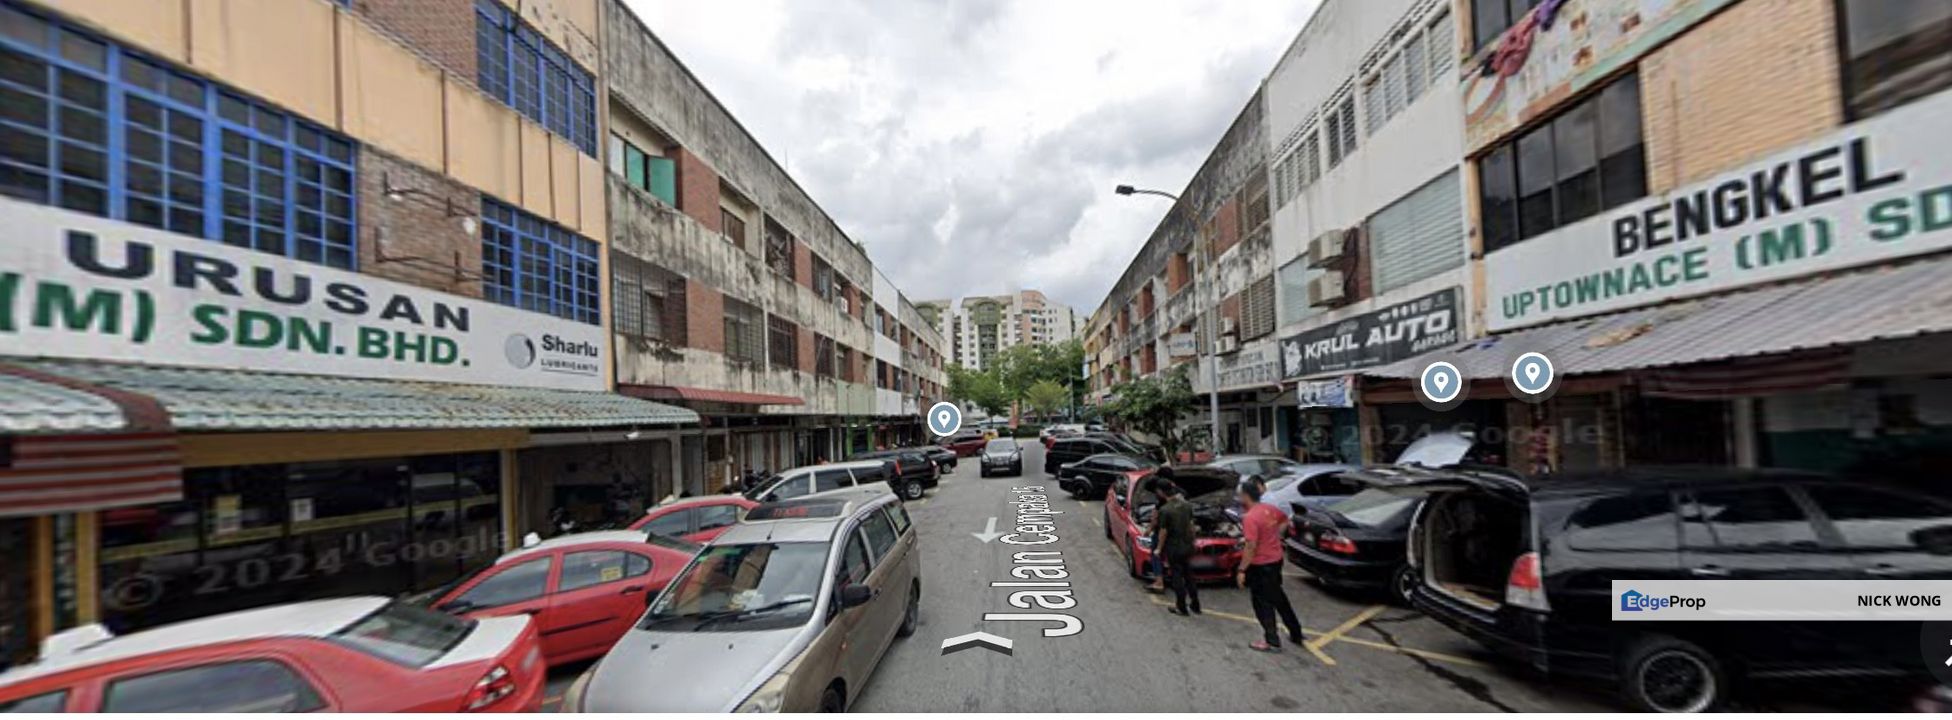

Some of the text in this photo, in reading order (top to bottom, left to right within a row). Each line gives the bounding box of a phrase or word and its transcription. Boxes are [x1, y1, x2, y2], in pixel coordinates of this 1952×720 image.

[1613, 136, 1905, 258] BENGKEL
[0, 271, 155, 343] (M)
[190, 303, 346, 355] SDN.
[65, 228, 471, 333] URUSAN
[1502, 247, 1710, 320] UPTOWNACE
[1735, 217, 1832, 270] (M)
[541, 334, 599, 358] Sharlu
[1303, 333, 1361, 360] KRUL
[1364, 309, 1451, 348] AUTO
